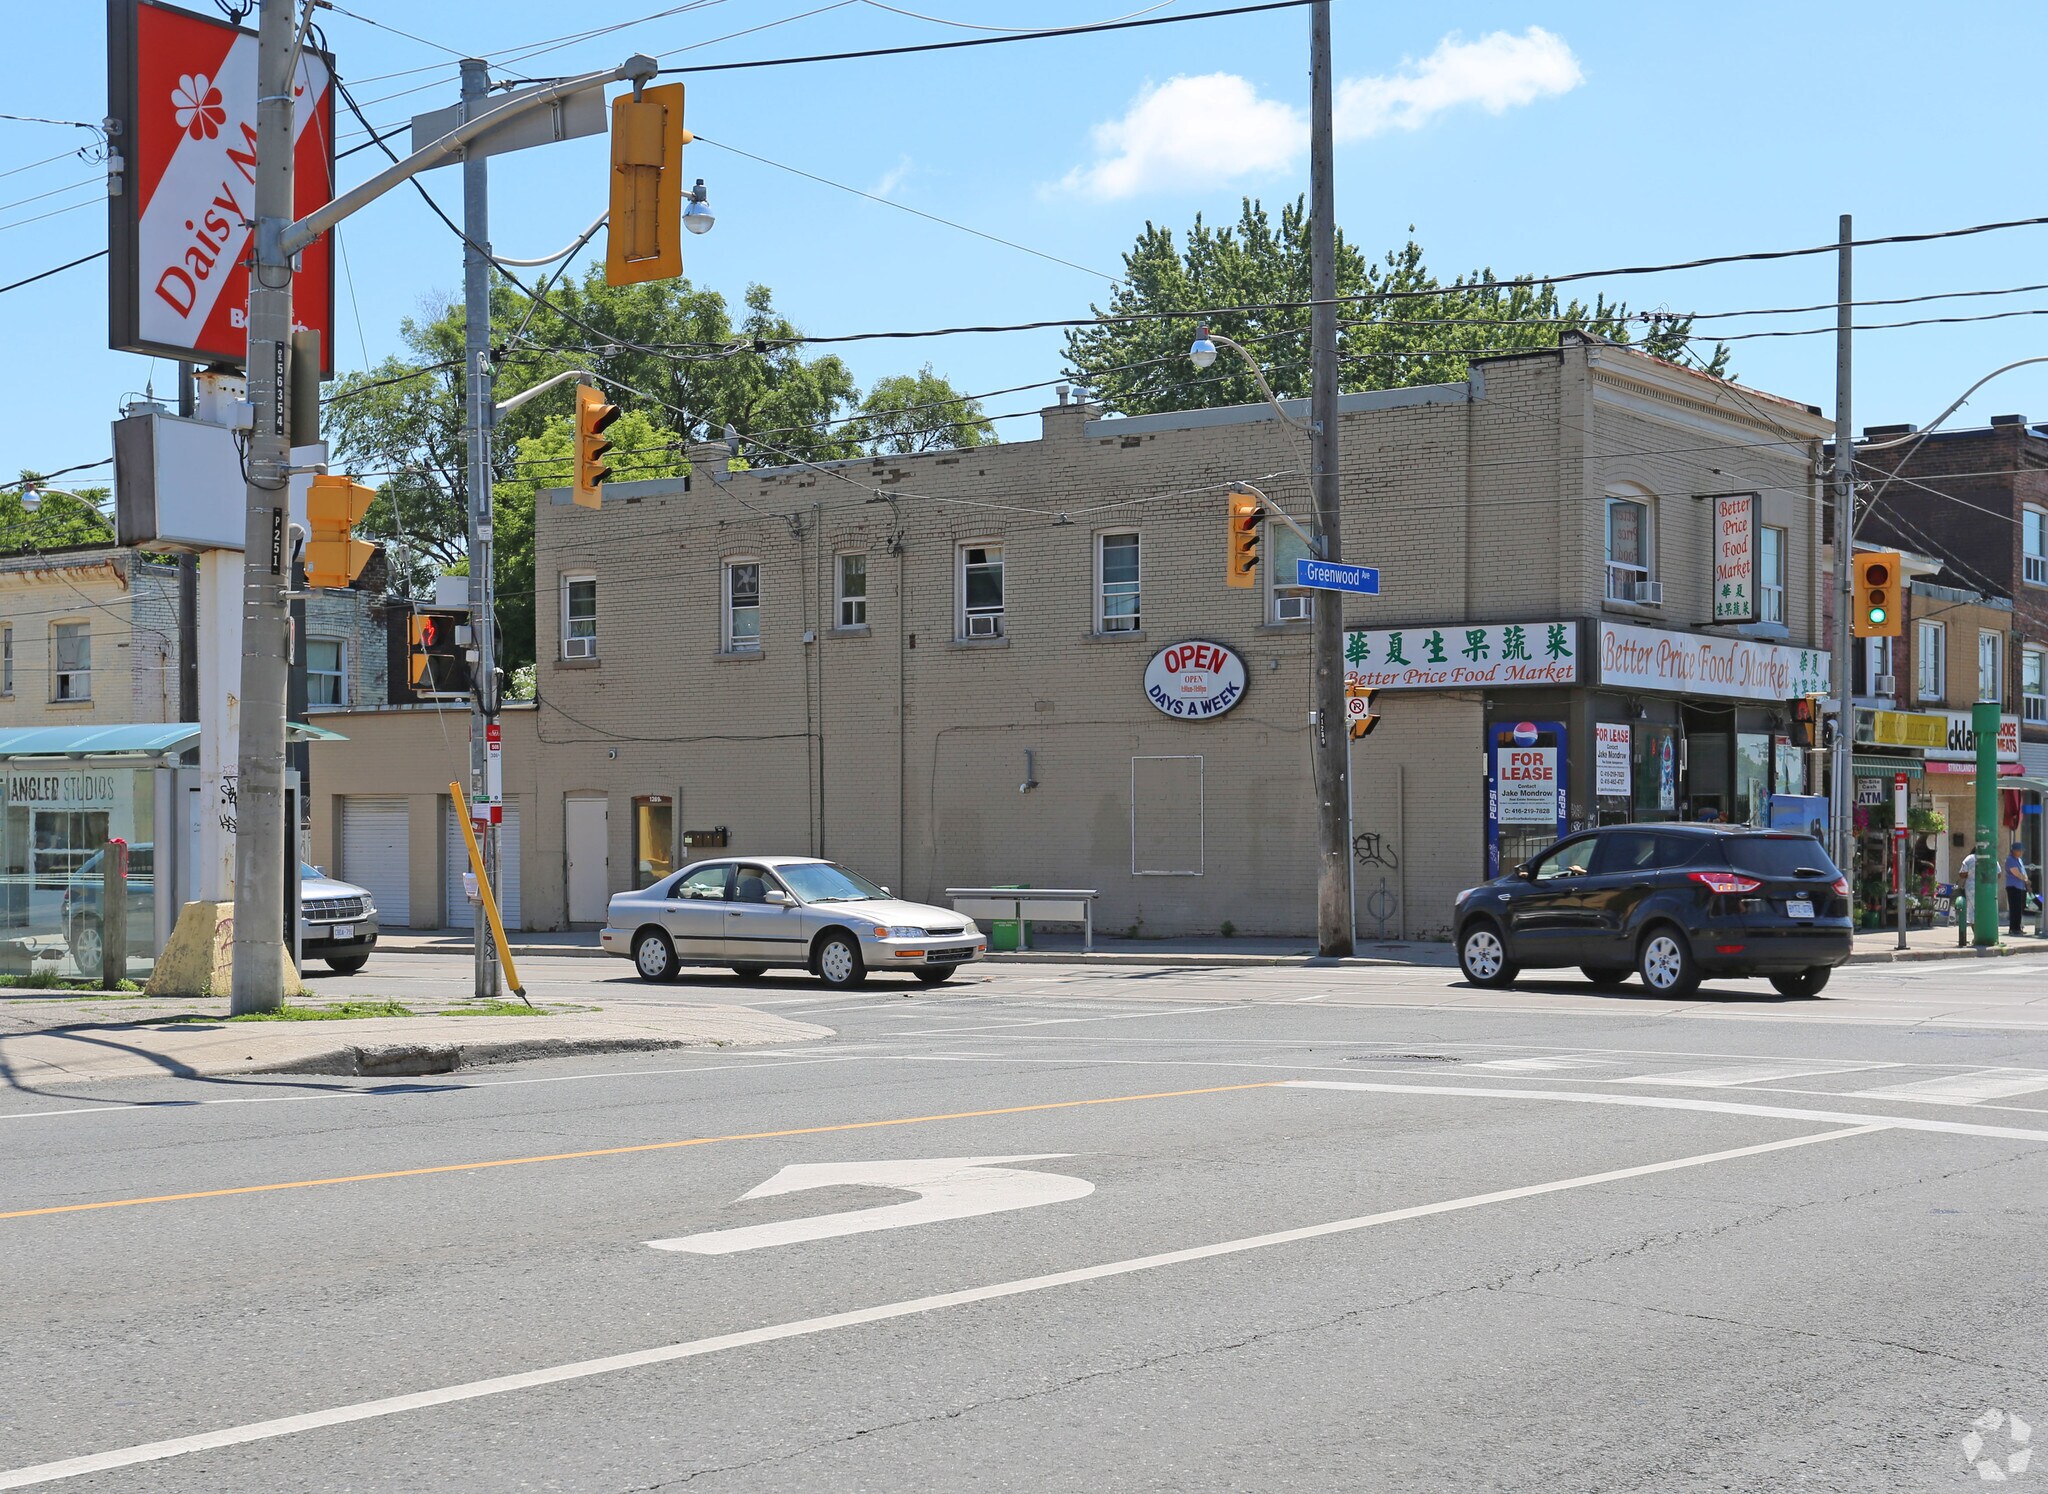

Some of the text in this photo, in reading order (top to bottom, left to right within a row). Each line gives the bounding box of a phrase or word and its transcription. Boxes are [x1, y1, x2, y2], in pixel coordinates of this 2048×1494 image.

[155, 182, 253, 319] Daisy
[1719, 499, 1750, 517] Better
[1723, 517, 1748, 536] Price
[1722, 535, 1748, 558] Food
[1307, 563, 1370, 585] Greenwood Ave
[1717, 558, 1751, 582] Market
[1164, 645, 1228, 674] OPEN
[1602, 631, 1790, 699] Better Price Food Market
[1184, 675, 1203, 683] OPEN
[1344, 661, 1574, 686] Better Price Food Market
[1149, 681, 1240, 715] DAYS A WEEK
[1595, 728, 1629, 743] FOR LEASE
[1511, 752, 1544, 766] FOR
[1501, 767, 1553, 781] LEASE
[64, 776, 114, 801] STUDIOS
[1858, 792, 1881, 804] ATM
[1489, 789, 1497, 820] PEPSI
[1558, 788, 1566, 819] PEPSI
